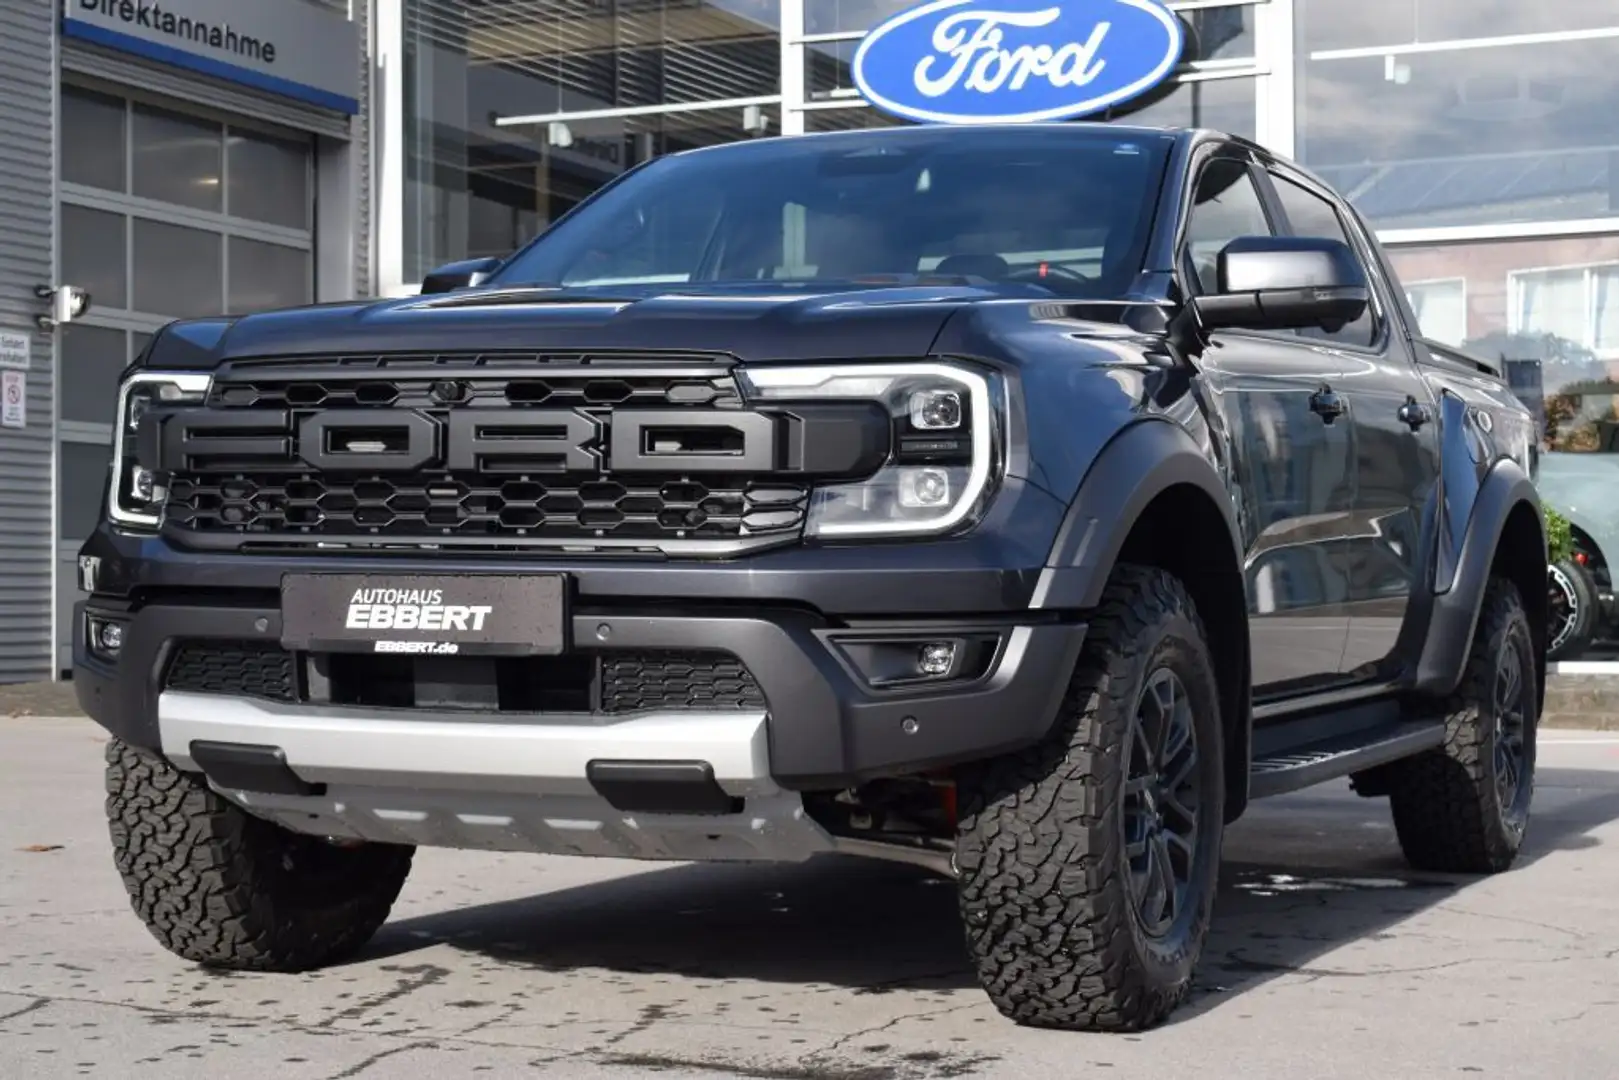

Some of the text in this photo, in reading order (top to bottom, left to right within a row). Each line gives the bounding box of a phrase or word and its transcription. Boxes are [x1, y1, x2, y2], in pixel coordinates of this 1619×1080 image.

[914, 7, 1111, 97] Ford
[158, 406, 780, 472] FORD
[350, 588, 443, 605] AUTOHAUS
[345, 604, 492, 630] EBBERT
[374, 641, 459, 654] EBBERT.de
